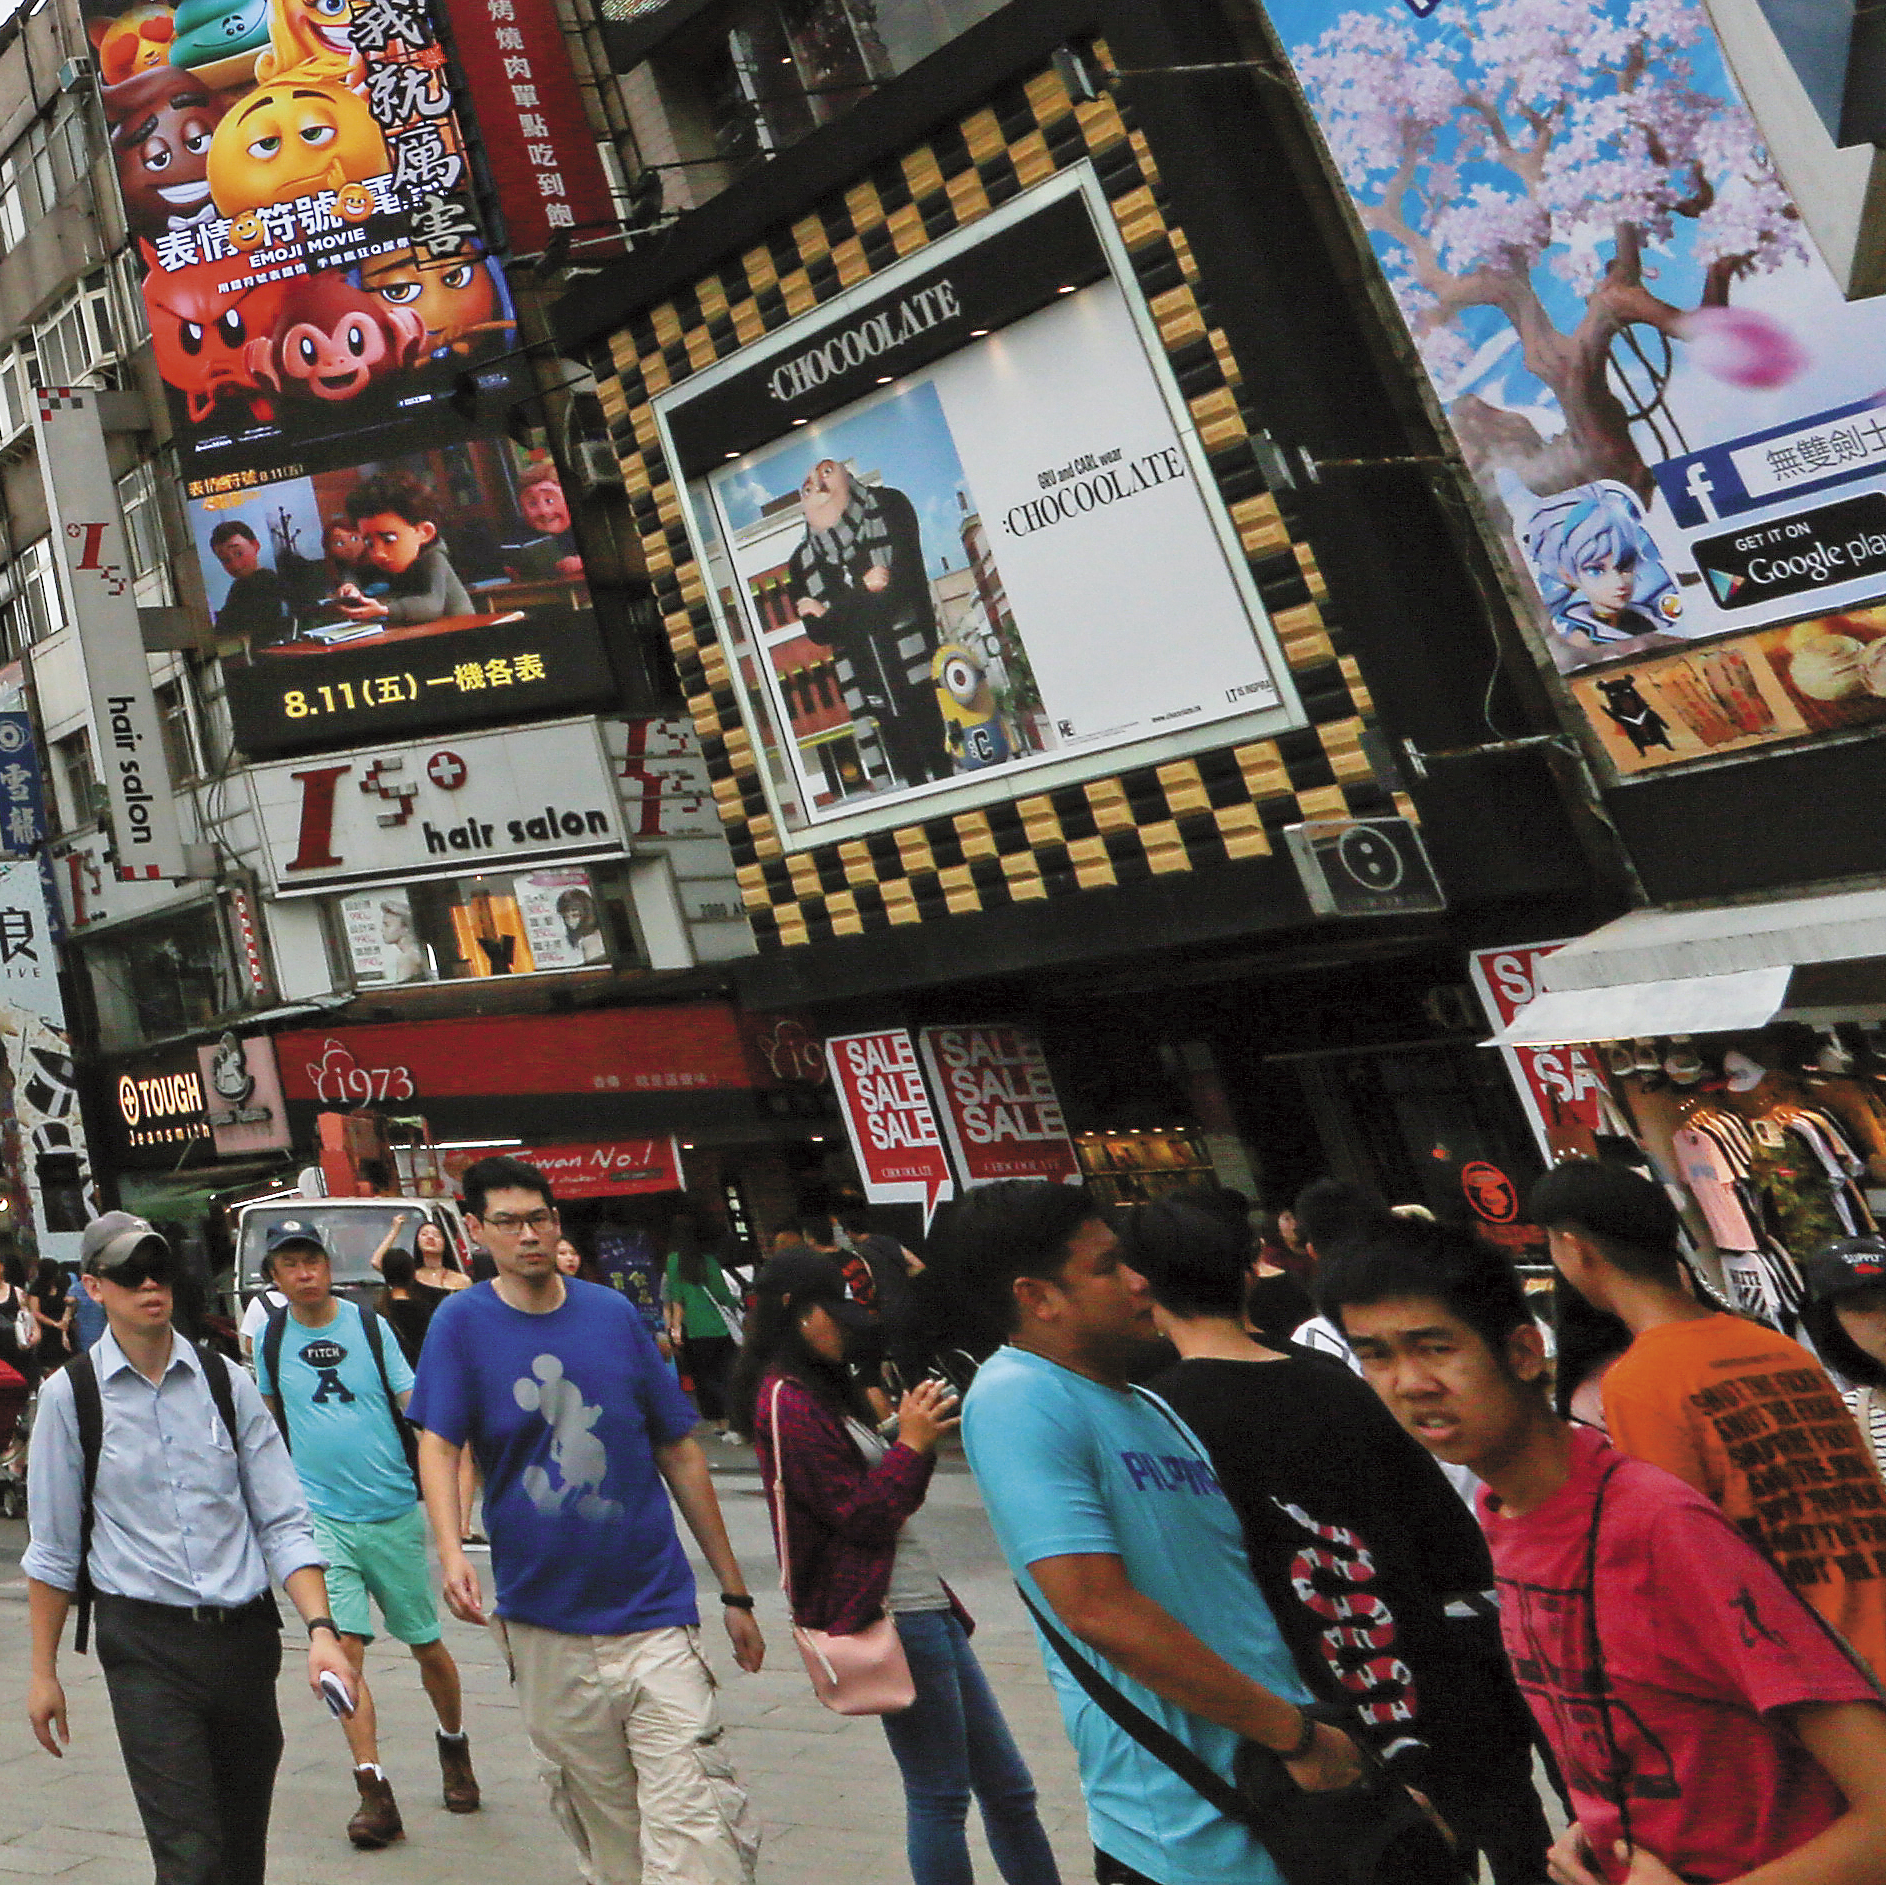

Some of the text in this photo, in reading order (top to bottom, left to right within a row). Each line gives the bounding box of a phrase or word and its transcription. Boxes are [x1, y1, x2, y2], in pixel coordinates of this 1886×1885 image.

[249, 227, 367, 269] EMOJI MOVIE
[1735, 520, 1812, 552] GET IT ON
[1747, 532, 1886, 587] Google pla
[284, 652, 548, 720] 8.11(五) 一機各表
[108, 696, 154, 845] hair salon
[423, 807, 611, 853] hair salon
[846, 1033, 918, 1078] SALE
[939, 1028, 1044, 1069] SALE
[139, 1072, 204, 1117] TOUGH
[857, 1071, 929, 1114] SALE
[951, 1065, 1058, 1107] SALE
[129, 1123, 210, 1147] Jeansmith
[868, 1109, 941, 1151] SALE
[962, 1102, 1070, 1144] SALE
[307, 1346, 341, 1360] FITCH
[312, 1368, 355, 1404] A
